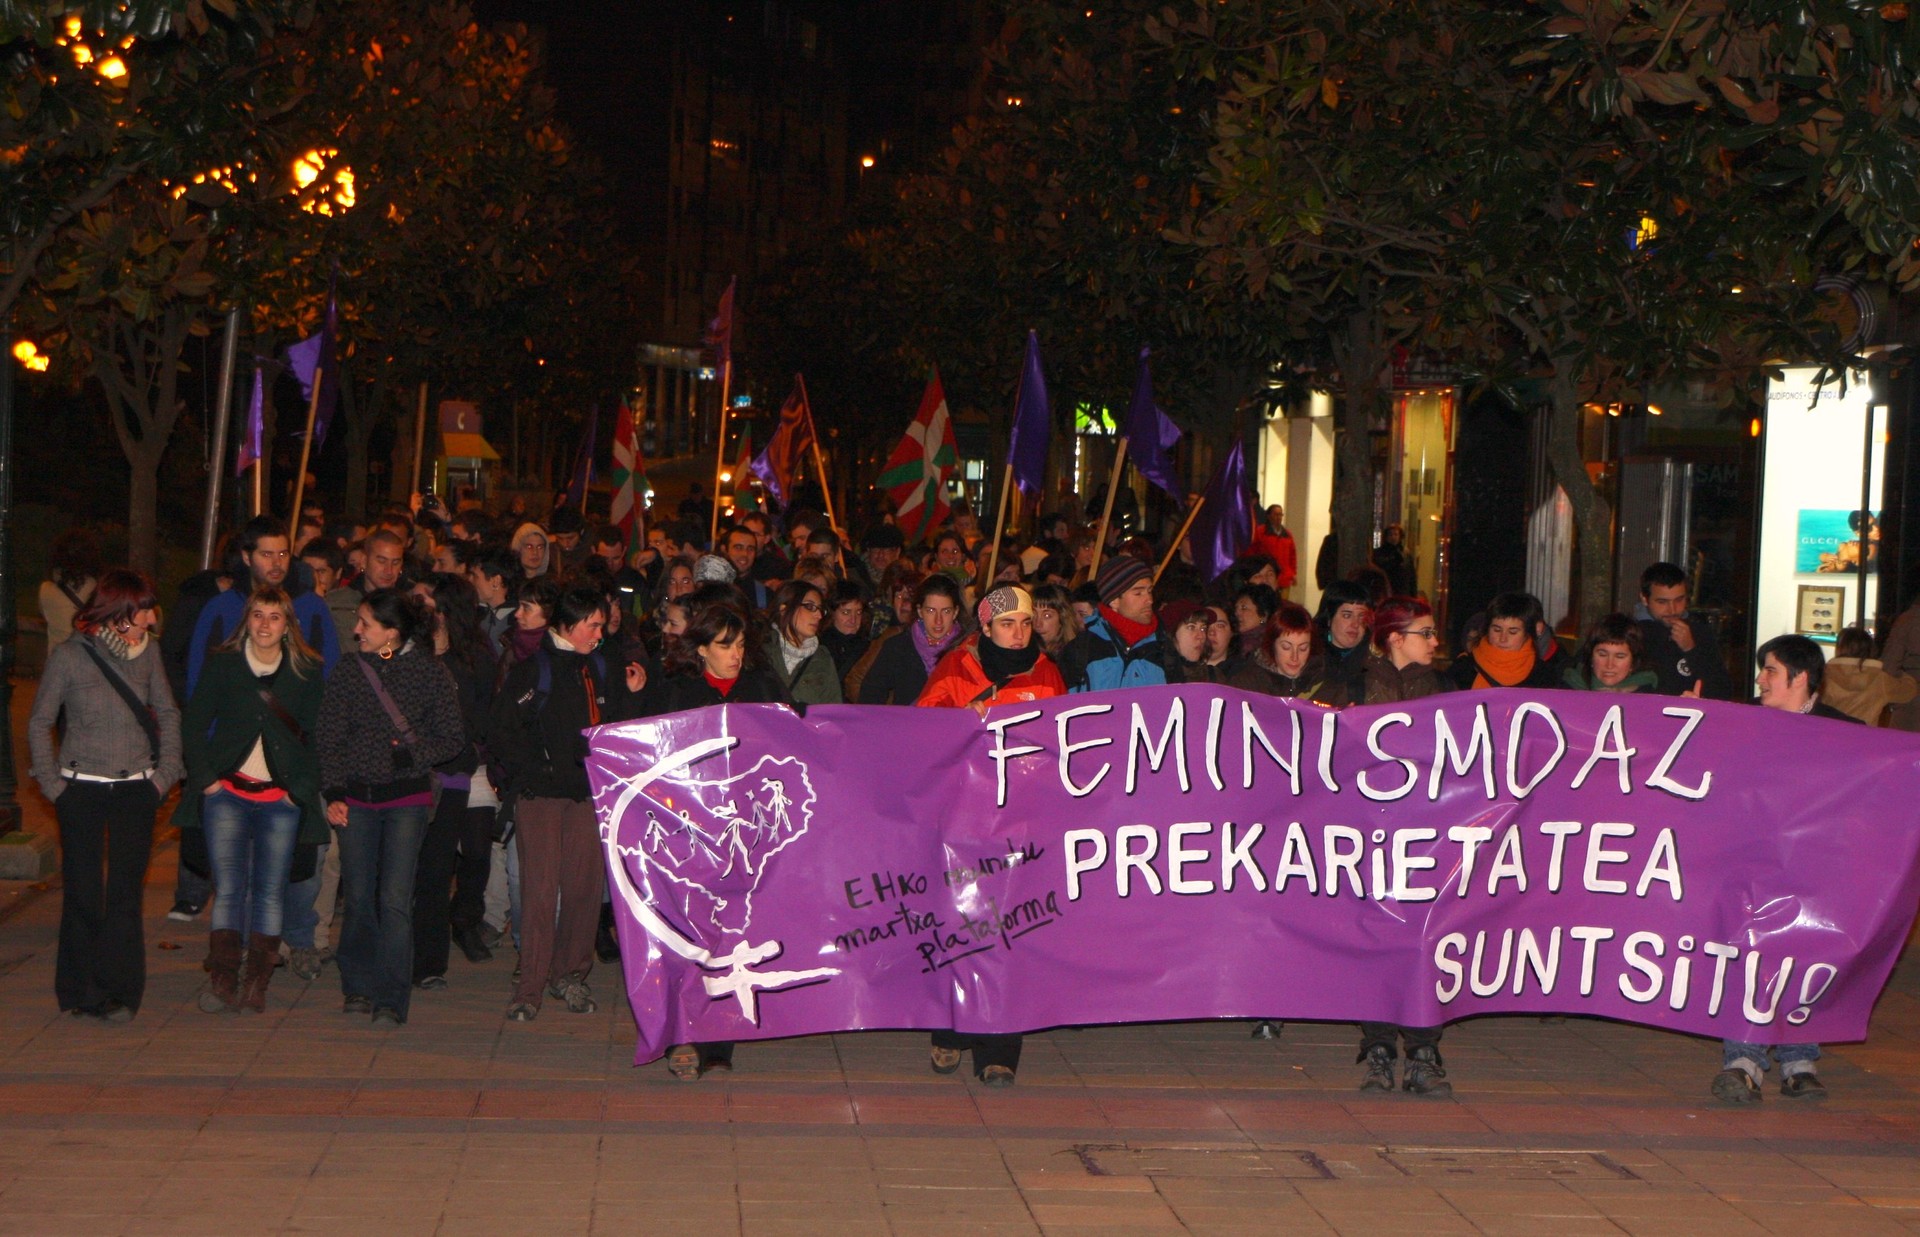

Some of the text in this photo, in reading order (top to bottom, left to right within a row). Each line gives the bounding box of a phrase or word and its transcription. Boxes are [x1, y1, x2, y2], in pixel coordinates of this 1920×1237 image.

[1801, 536, 1839, 545] GUCCI
[986, 696, 1713, 808] FEMINISMOAZ
[835, 901, 946, 952] martxa
